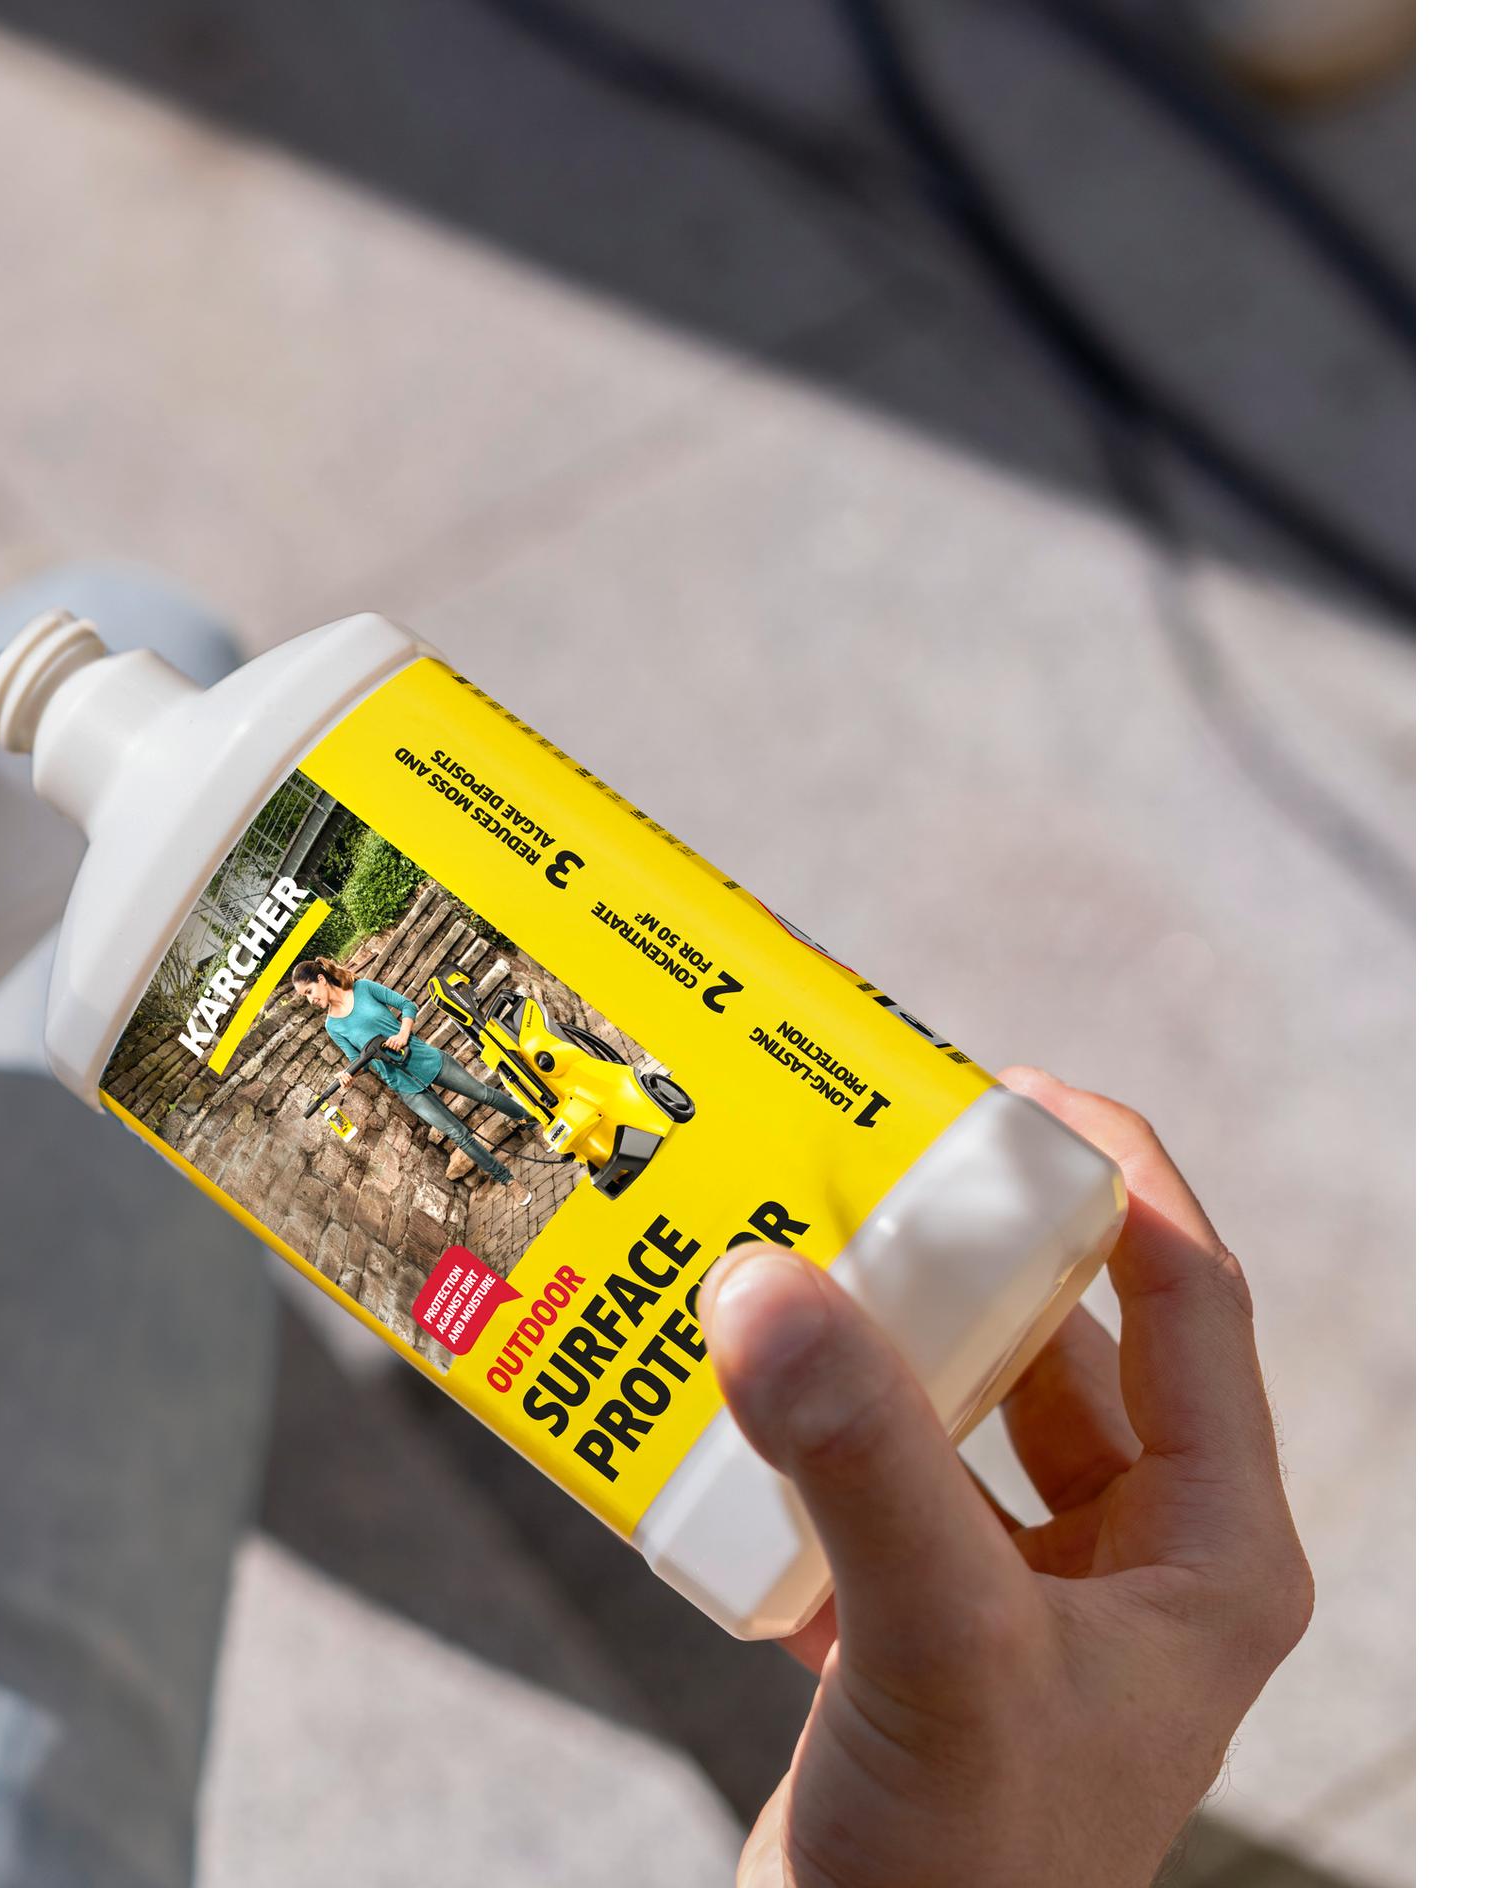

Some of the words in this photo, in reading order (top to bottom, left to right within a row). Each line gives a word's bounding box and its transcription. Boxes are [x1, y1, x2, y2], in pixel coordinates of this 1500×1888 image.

[394, 747, 432, 777] AND
[430, 750, 505, 810] DEPOSITS
[427, 773, 474, 812] MOSS
[471, 807, 541, 866] REDUCES
[501, 804, 556, 848] ALGAE
[545, 850, 585, 890] 3
[178, 877, 310, 1058] KÄRCHER
[591, 901, 698, 989] CONCENTRATE
[657, 927, 681, 949] 50
[679, 942, 713, 974] FOR
[702, 970, 744, 1014] 2
[749, 1027, 854, 1113] LONG-LASTING
[776, 1020, 868, 1096] PROTECTION
[853, 1090, 891, 1128] 1
[423, 1265, 464, 1324] PROTECTION
[436, 1291, 465, 1334] AGAINST
[460, 1269, 479, 1295] DIRT
[448, 1320, 466, 1344] AND
[460, 1273, 496, 1323] MOISTURE
[486, 1265, 586, 1393] OUTDOOR
[522, 1214, 702, 1438] SURFACE
[573, 1201, 811, 1483] PROTER
